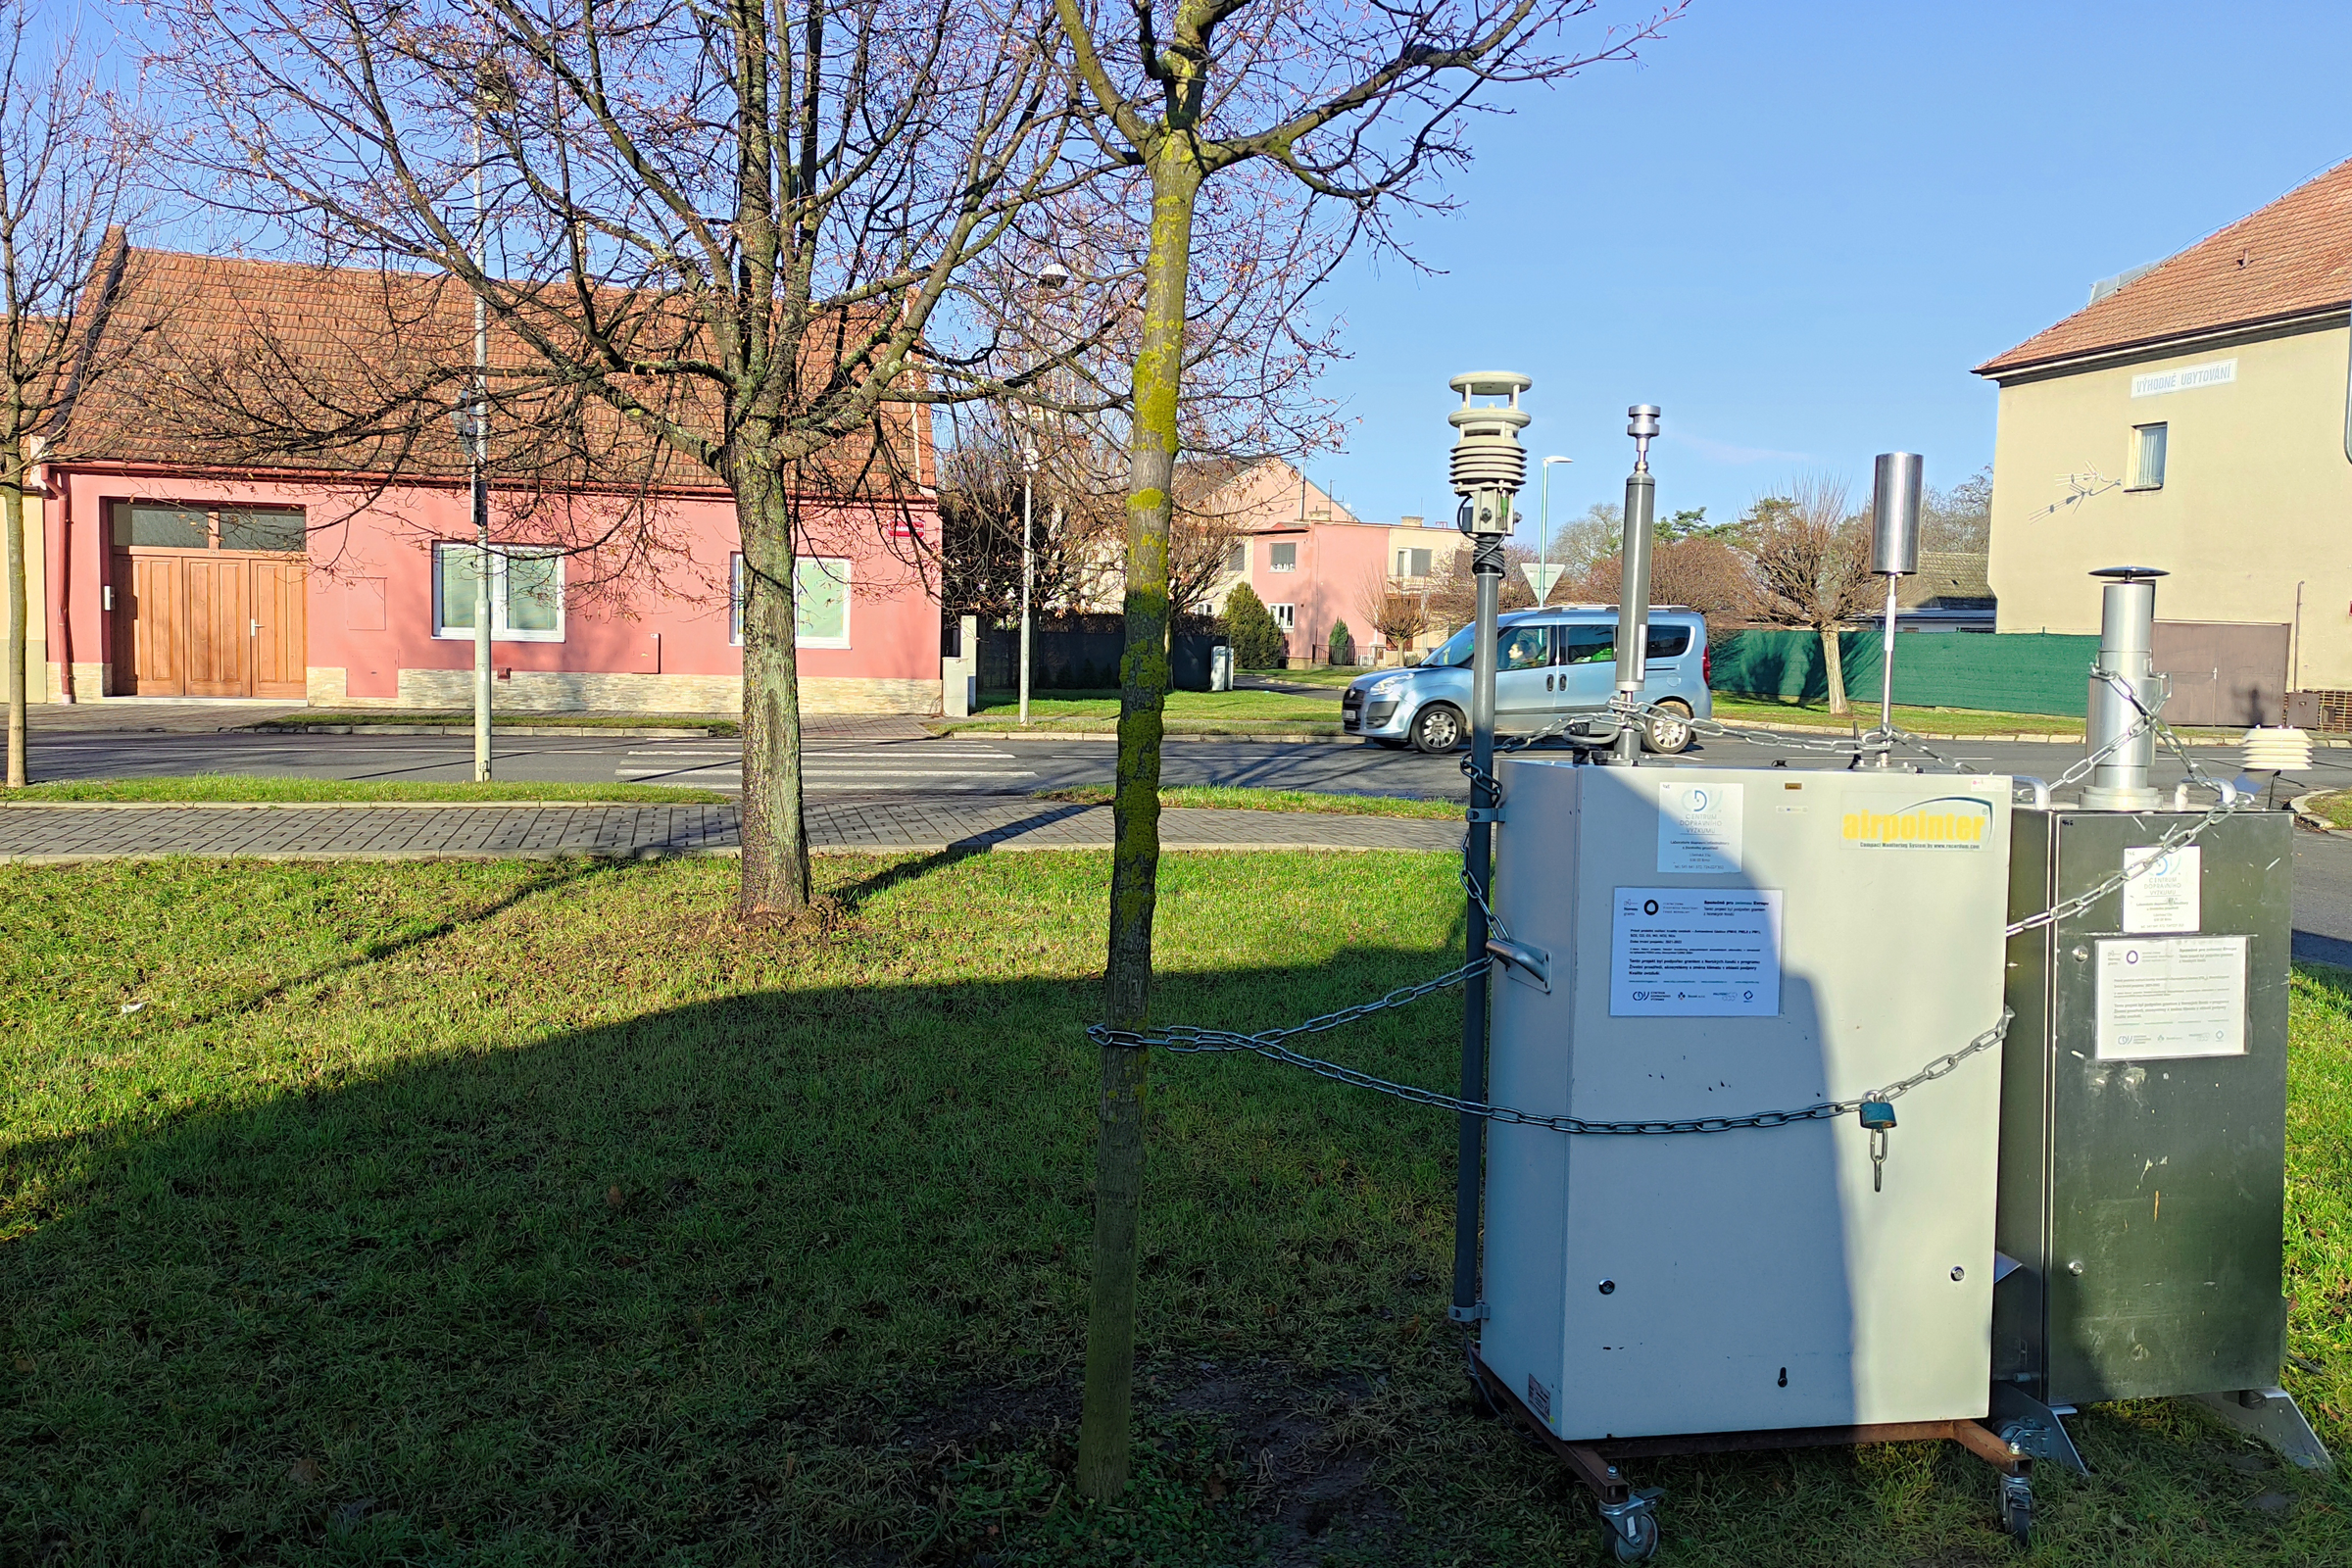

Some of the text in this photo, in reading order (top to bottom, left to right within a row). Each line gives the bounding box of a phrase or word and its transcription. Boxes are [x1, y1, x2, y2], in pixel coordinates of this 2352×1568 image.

[2136, 364, 2231, 393] VÝHODNÉ UBYTOVÁNÍ
[1842, 809, 1985, 842] airpointer
